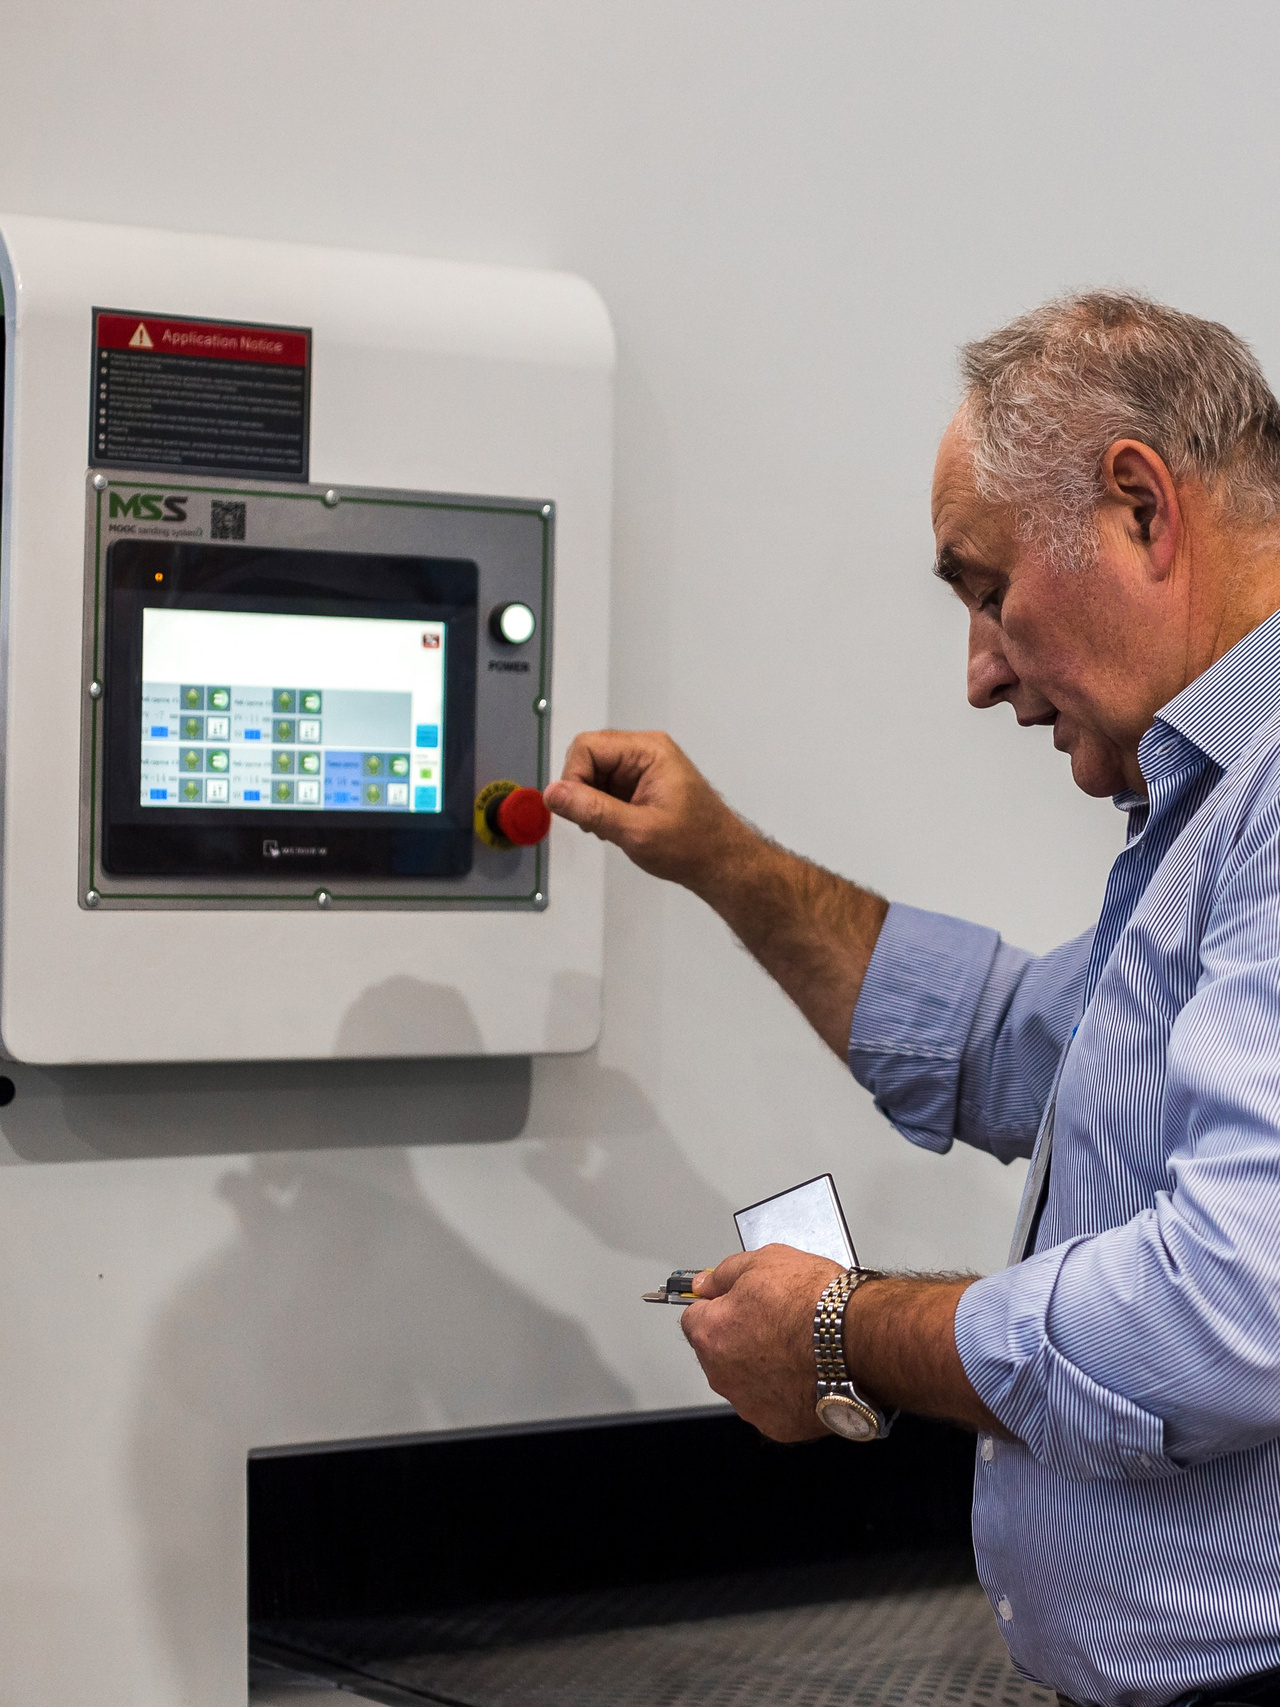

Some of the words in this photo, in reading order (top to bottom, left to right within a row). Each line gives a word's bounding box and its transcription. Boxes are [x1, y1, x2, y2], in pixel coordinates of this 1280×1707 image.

[162, 328, 238, 350] Application
[240, 336, 284, 354] Notice
[109, 491, 188, 522] MSS
[487, 660, 531, 673] POWER
